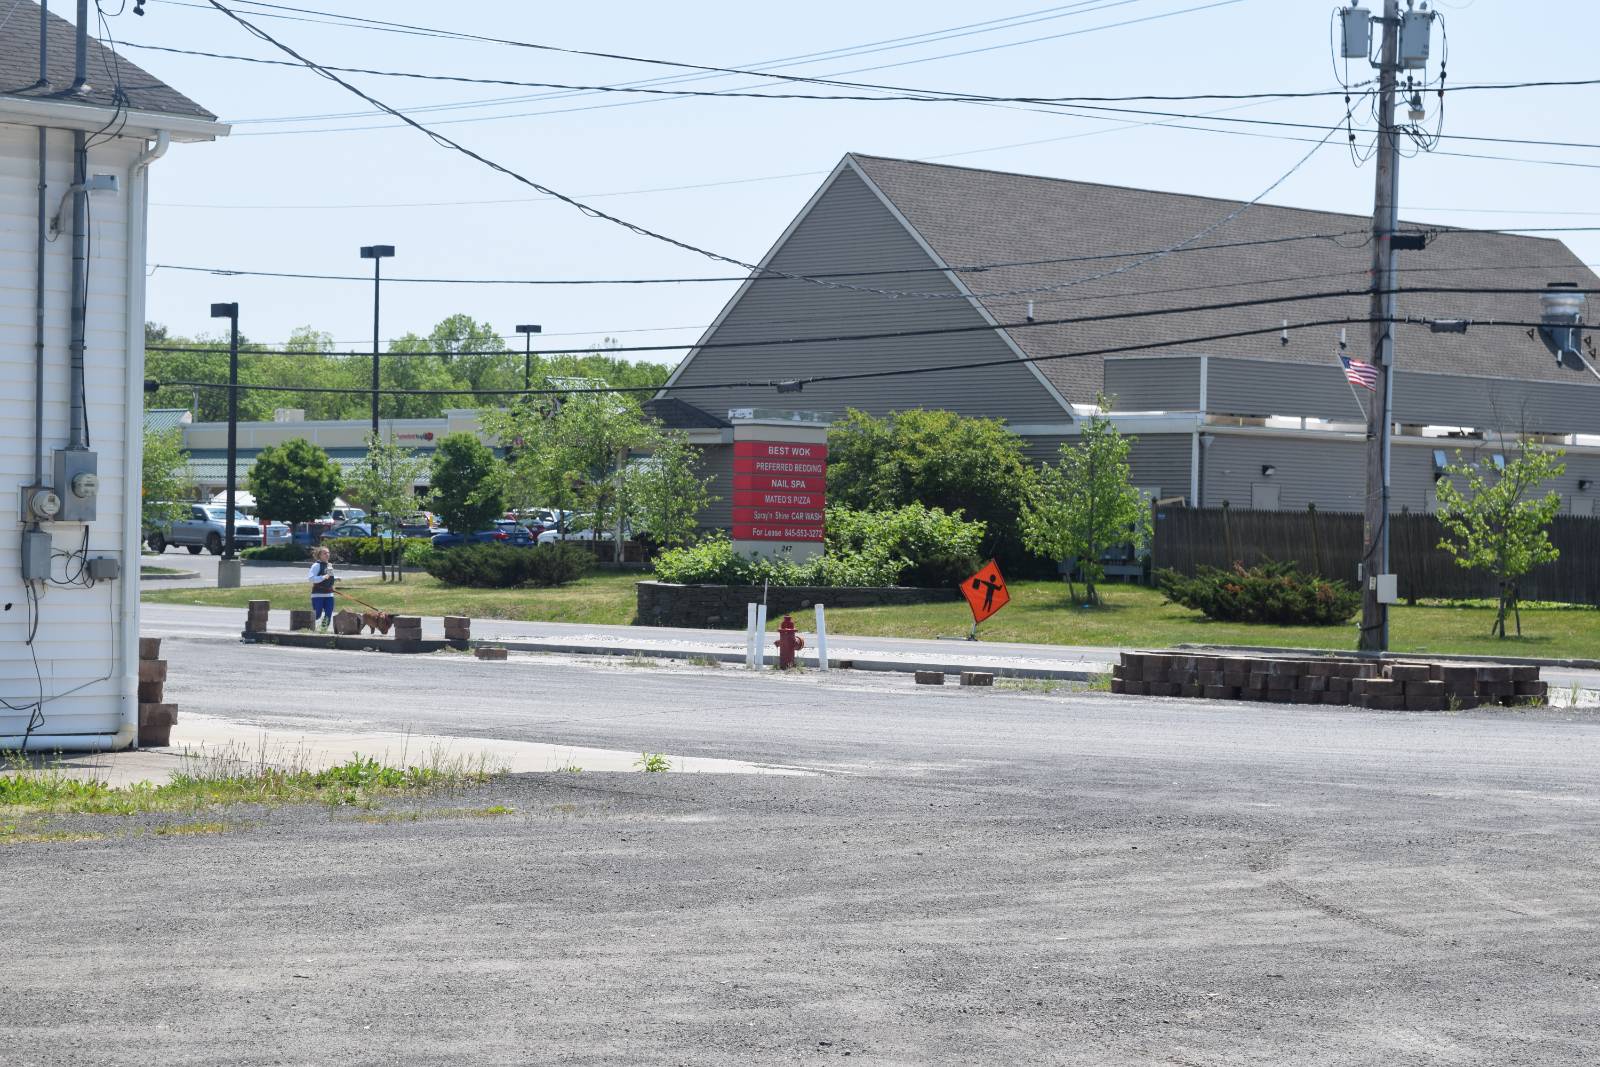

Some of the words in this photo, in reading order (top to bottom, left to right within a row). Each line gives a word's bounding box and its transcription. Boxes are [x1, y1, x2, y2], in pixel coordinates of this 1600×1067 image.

[768, 446, 789, 455] BEST
[791, 447, 811, 456] WOK
[756, 462, 793, 472] PREFERRED
[794, 463, 822, 473] BEDDING
[771, 479, 789, 488] NAIL
[790, 480, 806, 489] SPA
[793, 496, 811, 505] PIZZA
[791, 512, 804, 520] CAR
[805, 512, 823, 521] WASH
[752, 527, 763, 537] For
[764, 528, 782, 537] Lease
